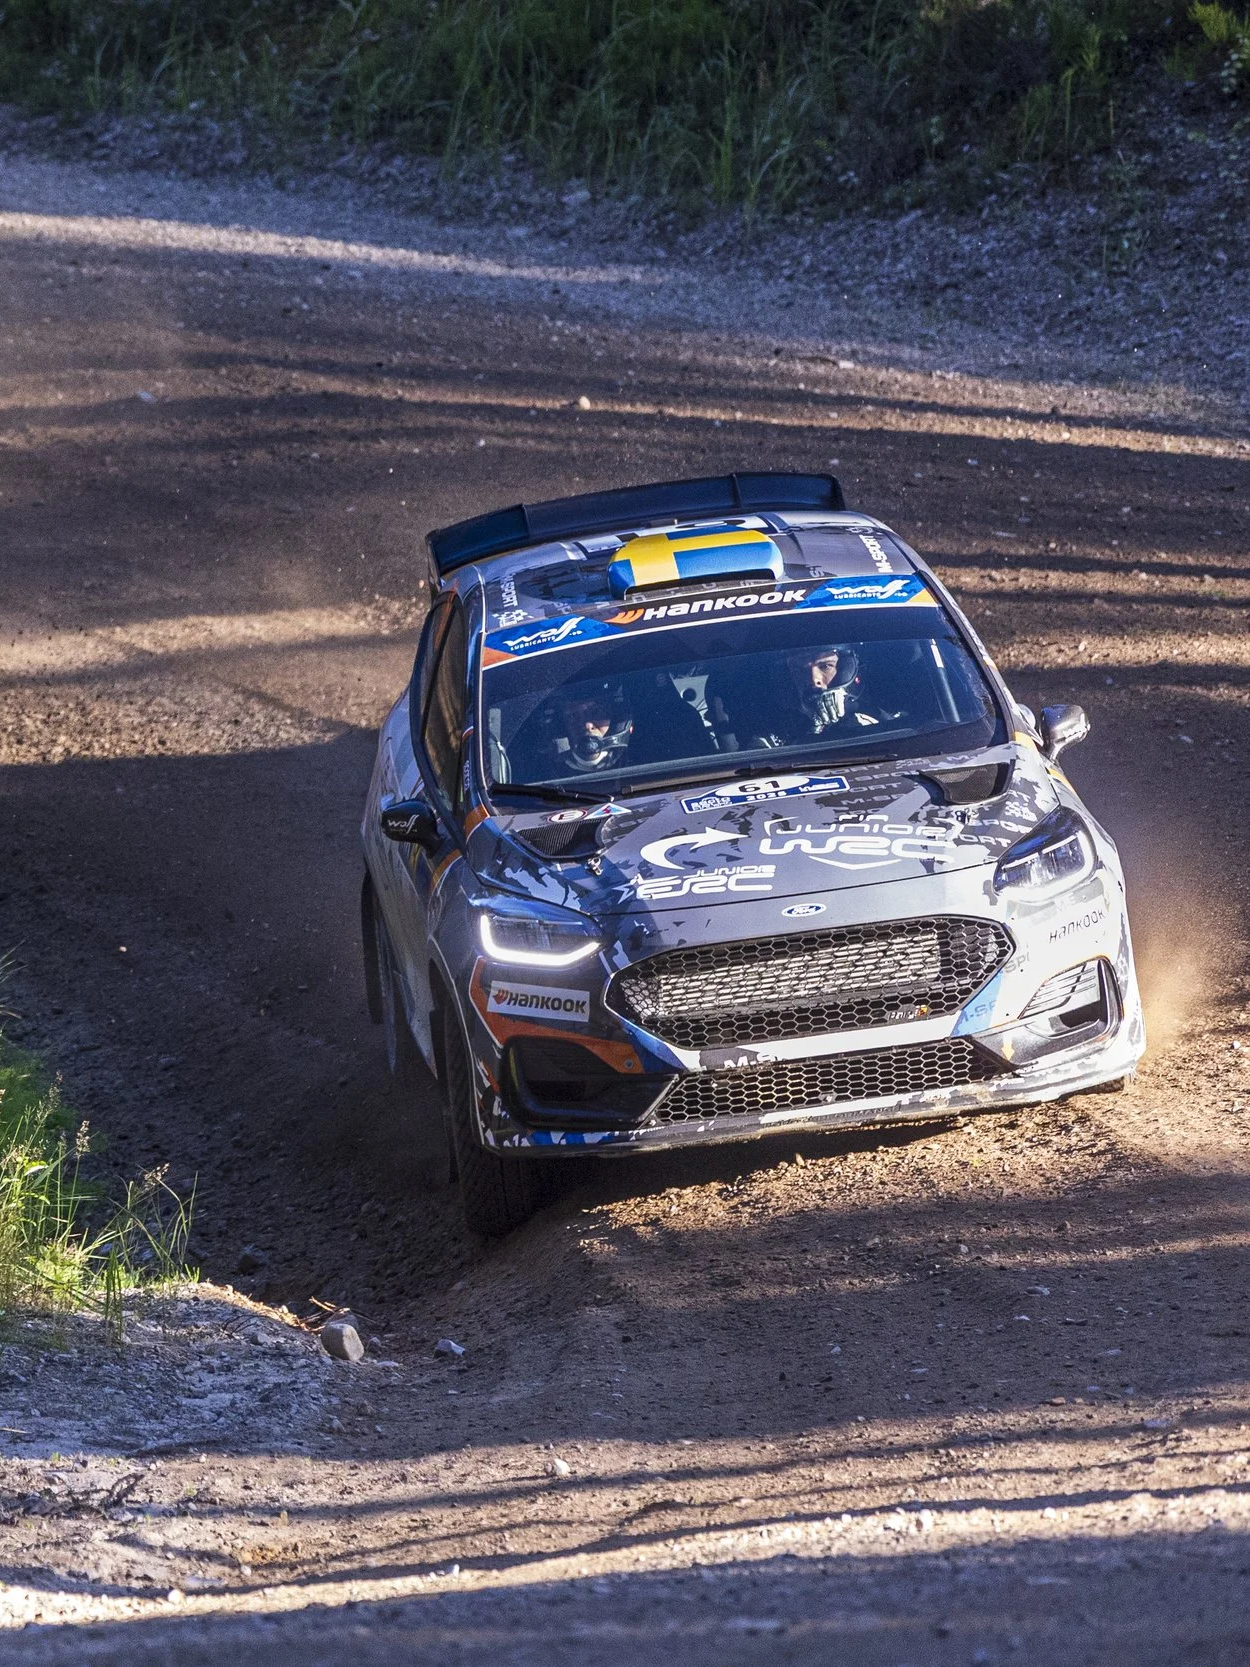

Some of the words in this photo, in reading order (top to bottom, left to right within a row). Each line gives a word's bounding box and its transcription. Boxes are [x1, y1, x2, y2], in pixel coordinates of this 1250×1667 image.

[738, 780, 780, 793] 61
[776, 824, 947, 837] JUNIOR
[759, 836, 957, 863] WRC
[683, 864, 777, 879] JUNIOR
[634, 872, 775, 900] ERC
